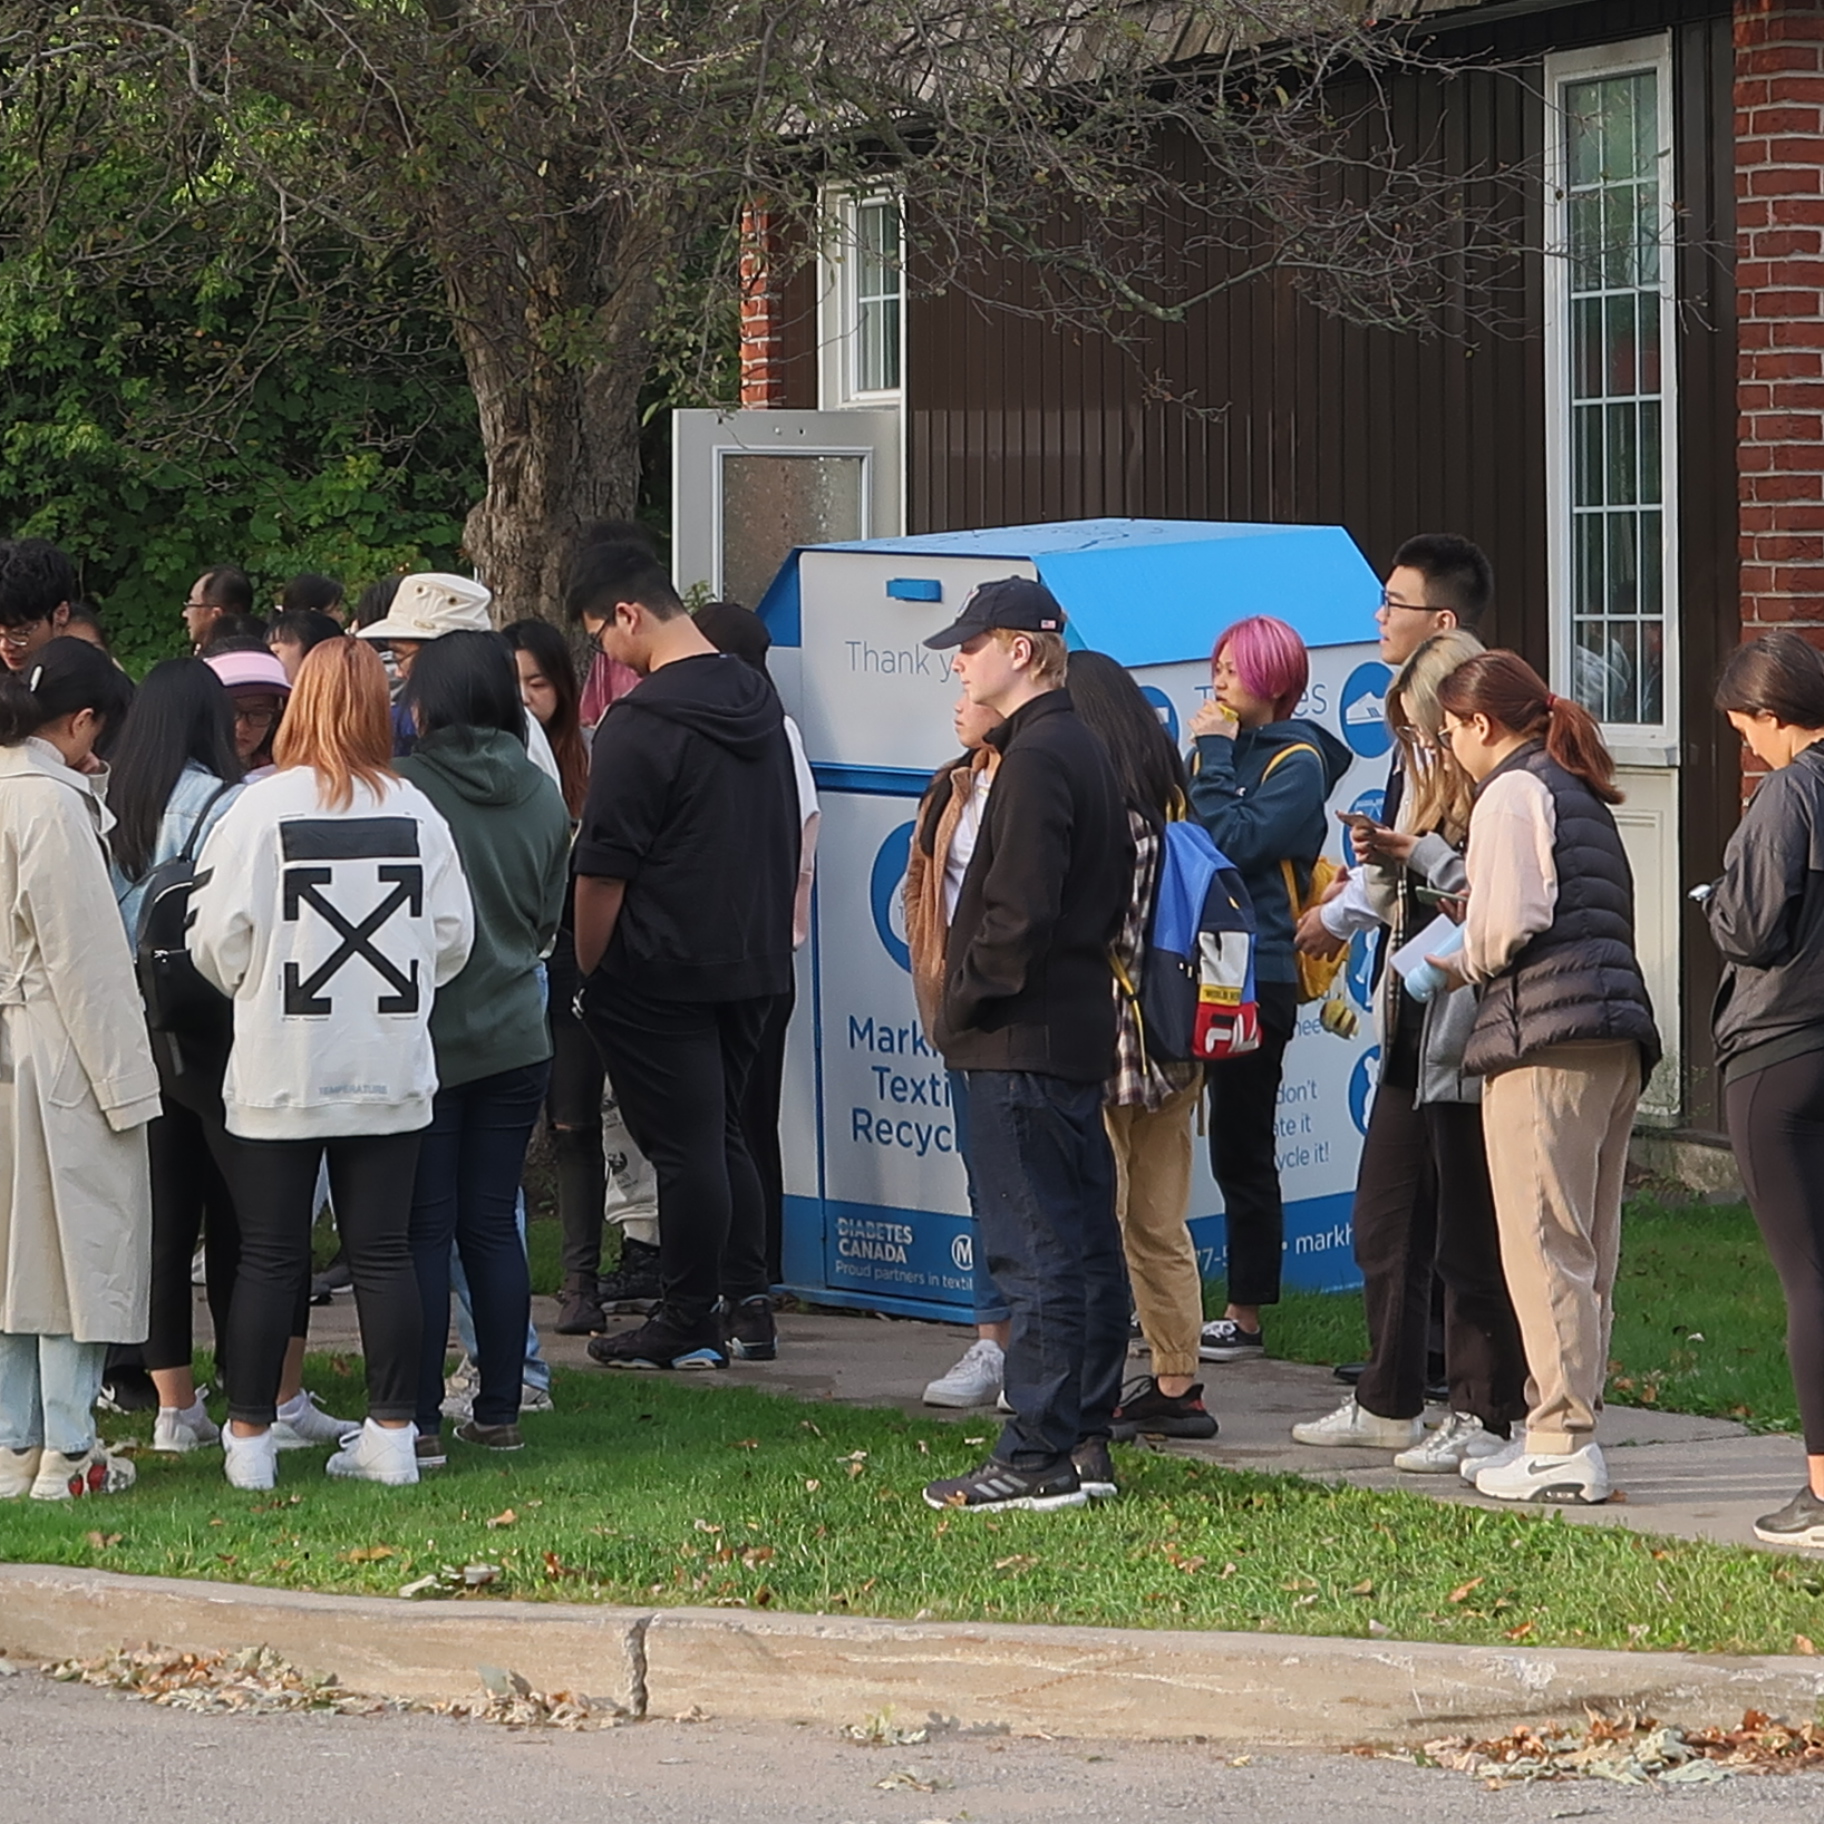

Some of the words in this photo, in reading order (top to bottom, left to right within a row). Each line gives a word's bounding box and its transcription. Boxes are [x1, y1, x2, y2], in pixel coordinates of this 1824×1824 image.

[845, 641, 930, 676] Thank
[849, 1015, 936, 1057] Mark
[319, 1084, 388, 1095] TEMPERATURE
[871, 1065, 950, 1107] Texti
[852, 1107, 960, 1157] Recycl
[1300, 1112, 1311, 1133] it
[1277, 1145, 1310, 1172] ycle
[1314, 1140, 1329, 1164] it!
[837, 1217, 913, 1245] DIABETES
[838, 1238, 907, 1264] CANADA
[835, 1260, 871, 1277] Proud
[875, 1268, 925, 1285] partners
[928, 1271, 940, 1285] in
[942, 1275, 973, 1291] textil
